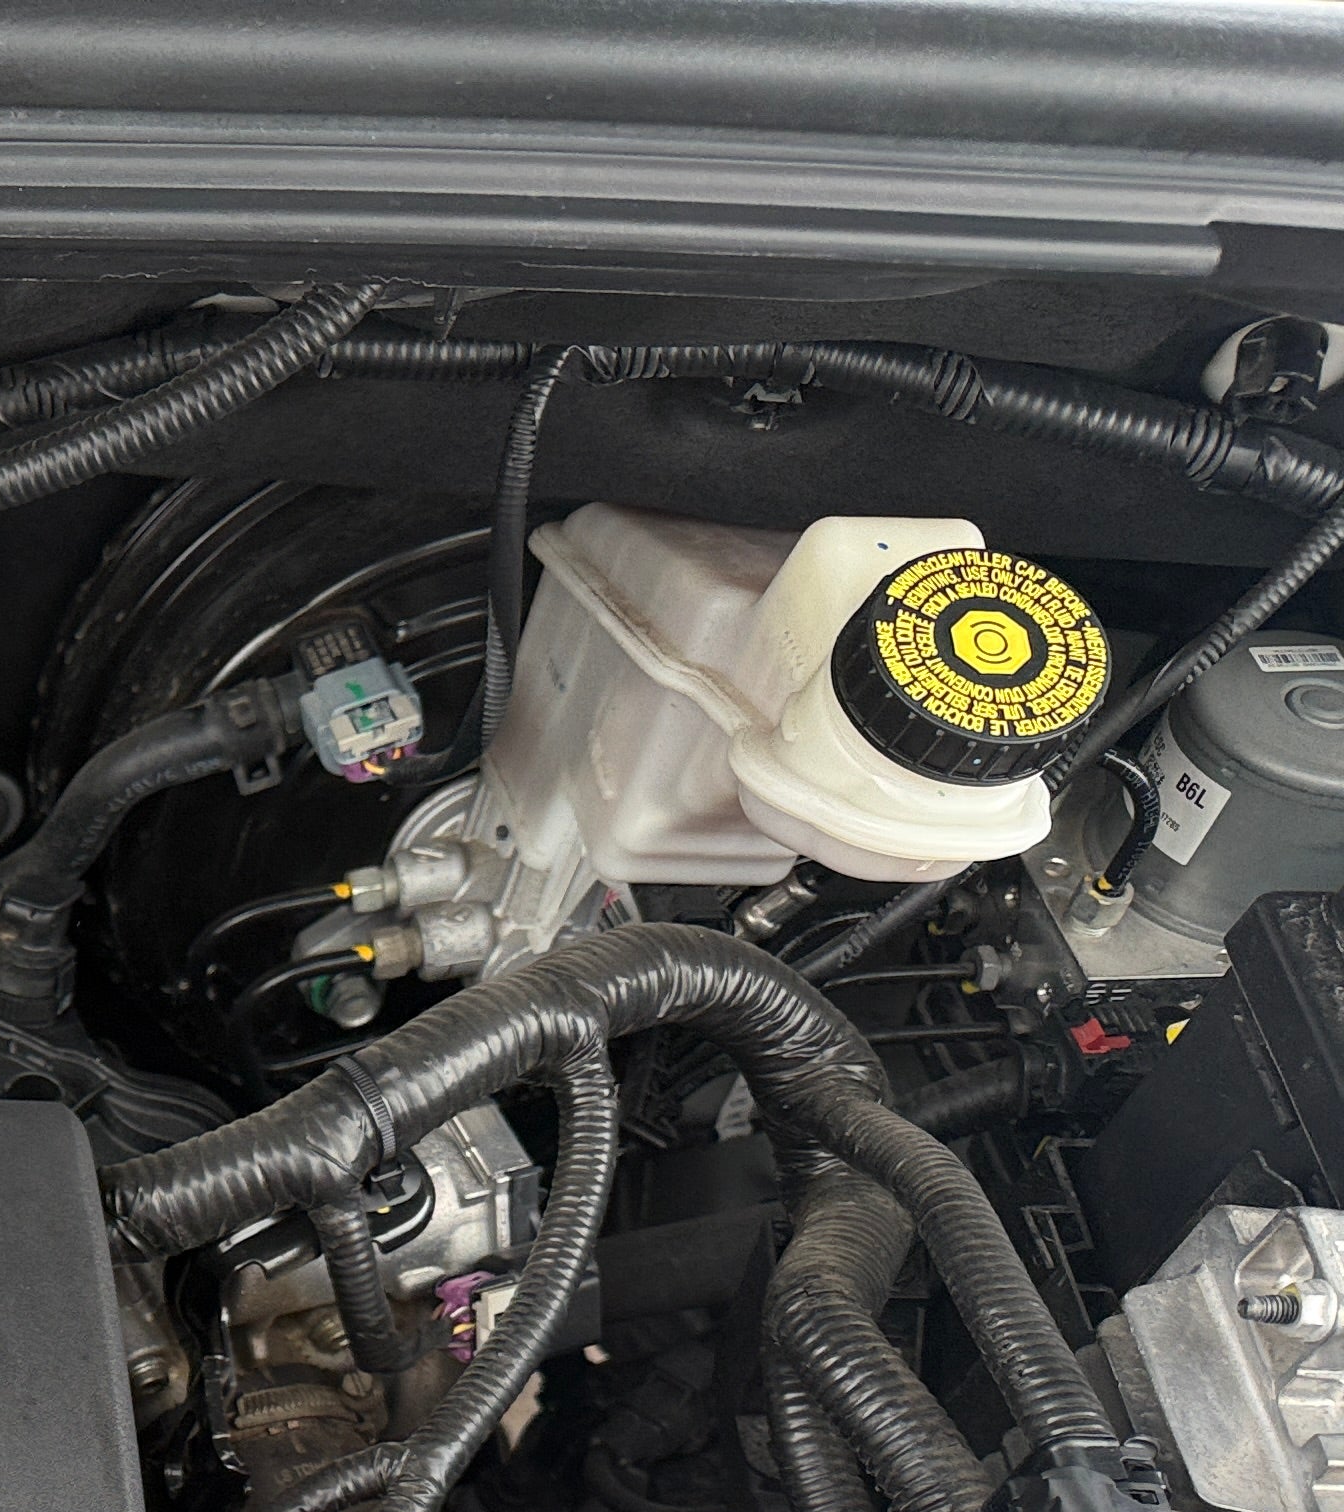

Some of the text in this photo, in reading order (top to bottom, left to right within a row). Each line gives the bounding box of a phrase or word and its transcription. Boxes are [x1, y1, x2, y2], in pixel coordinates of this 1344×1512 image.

[921, 591, 951, 619] FROM
[945, 587, 960, 602] A
[954, 582, 999, 599] SEALED
[961, 567, 989, 582] USE
[991, 568, 1023, 588] ONLY
[1020, 580, 1046, 600] DOT
[964, 550, 1012, 571] FILLER
[1014, 560, 1047, 581] CAP
[1044, 577, 1091, 620] BEFORE
[903, 681, 928, 702] DE
[923, 656, 994, 702] CONTENANT
[922, 696, 984, 733] BOUCHON
[989, 719, 1010, 737] LE
[1175, 772, 1208, 810] B6L
